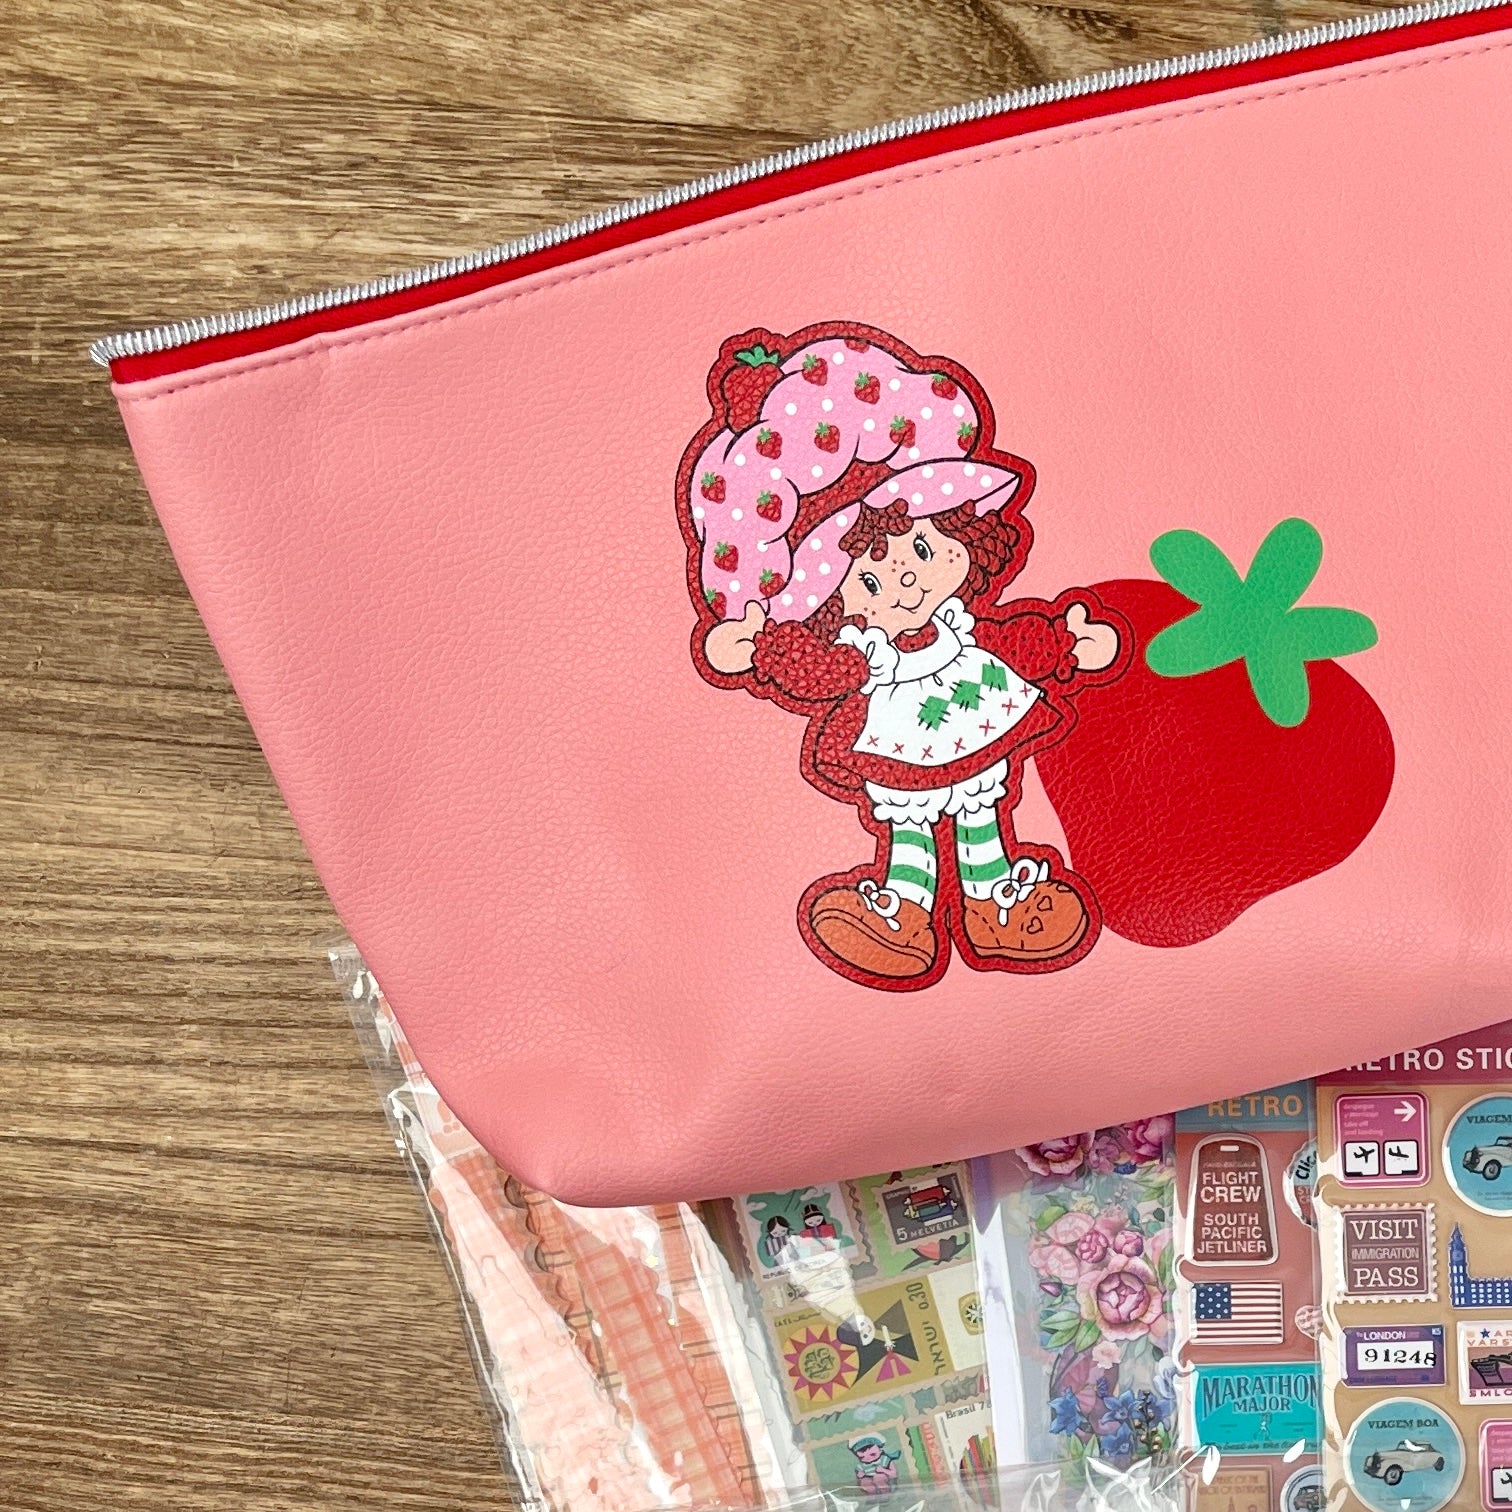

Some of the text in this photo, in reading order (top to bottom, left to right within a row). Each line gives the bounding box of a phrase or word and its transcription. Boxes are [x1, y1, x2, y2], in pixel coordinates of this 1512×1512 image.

[1207, 1095, 1302, 1117] RETRO
[1202, 1171, 1259, 1185] FLIGHT
[1200, 1186, 1261, 1203] CREW
[1203, 1212, 1259, 1226] SOUTH
[896, 1218, 960, 1241] 5 HELVETIA
[1201, 1226, 1262, 1240] PACIFIC
[1350, 1219, 1418, 1240] VISIT
[1197, 1239, 1267, 1254] JETLINER
[1351, 1247, 1419, 1260] IMMIGRATION
[1354, 1267, 1419, 1288] PASS
[1364, 1331, 1406, 1341] LONDON
[1364, 1348, 1437, 1367] 91248
[1202, 1374, 1321, 1419] MARATHON
[1232, 1396, 1291, 1413] MAJOR
